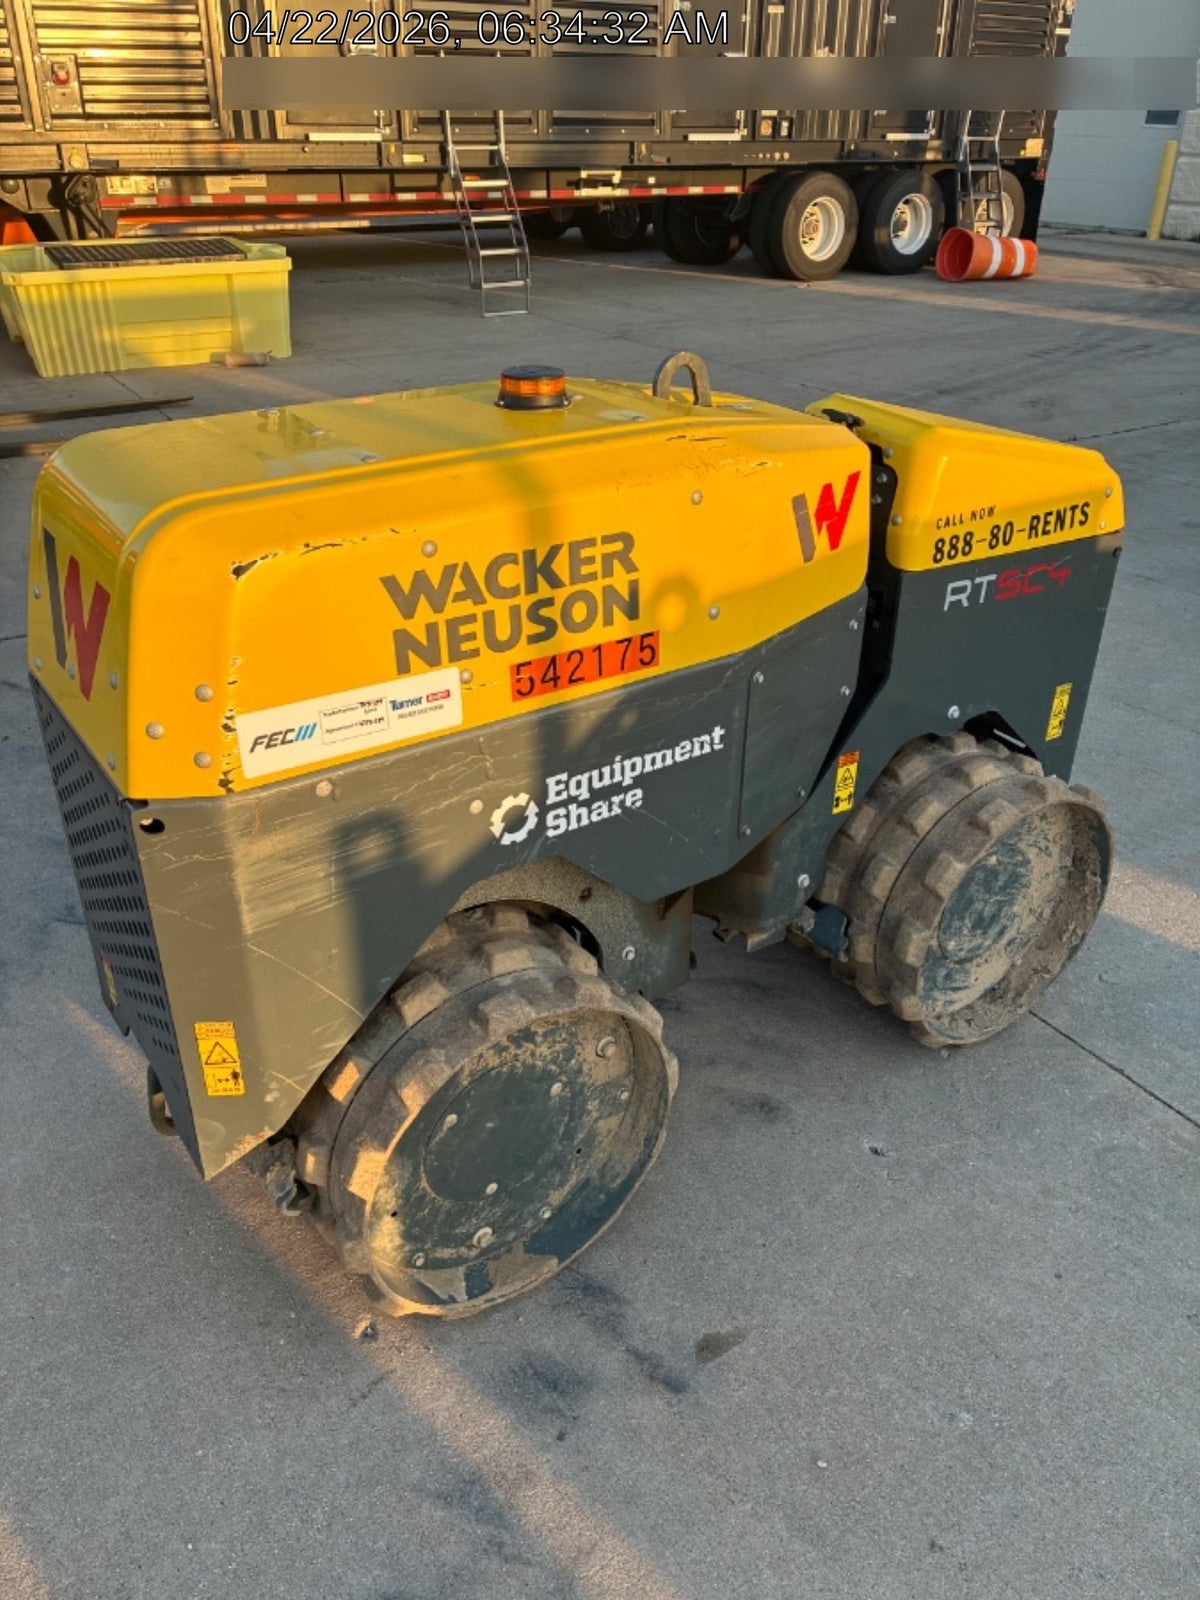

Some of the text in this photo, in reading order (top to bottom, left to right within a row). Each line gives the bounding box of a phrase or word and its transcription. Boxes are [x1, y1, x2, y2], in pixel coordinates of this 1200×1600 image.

[932, 501, 1091, 564] 888-80-RENTS
[936, 504, 996, 530] CALL NOW
[378, 531, 640, 621] WACKER
[392, 578, 641, 676] NEUSON
[514, 631, 658, 698] 542175
[545, 725, 726, 805] Equipment
[545, 787, 644, 838] Share
